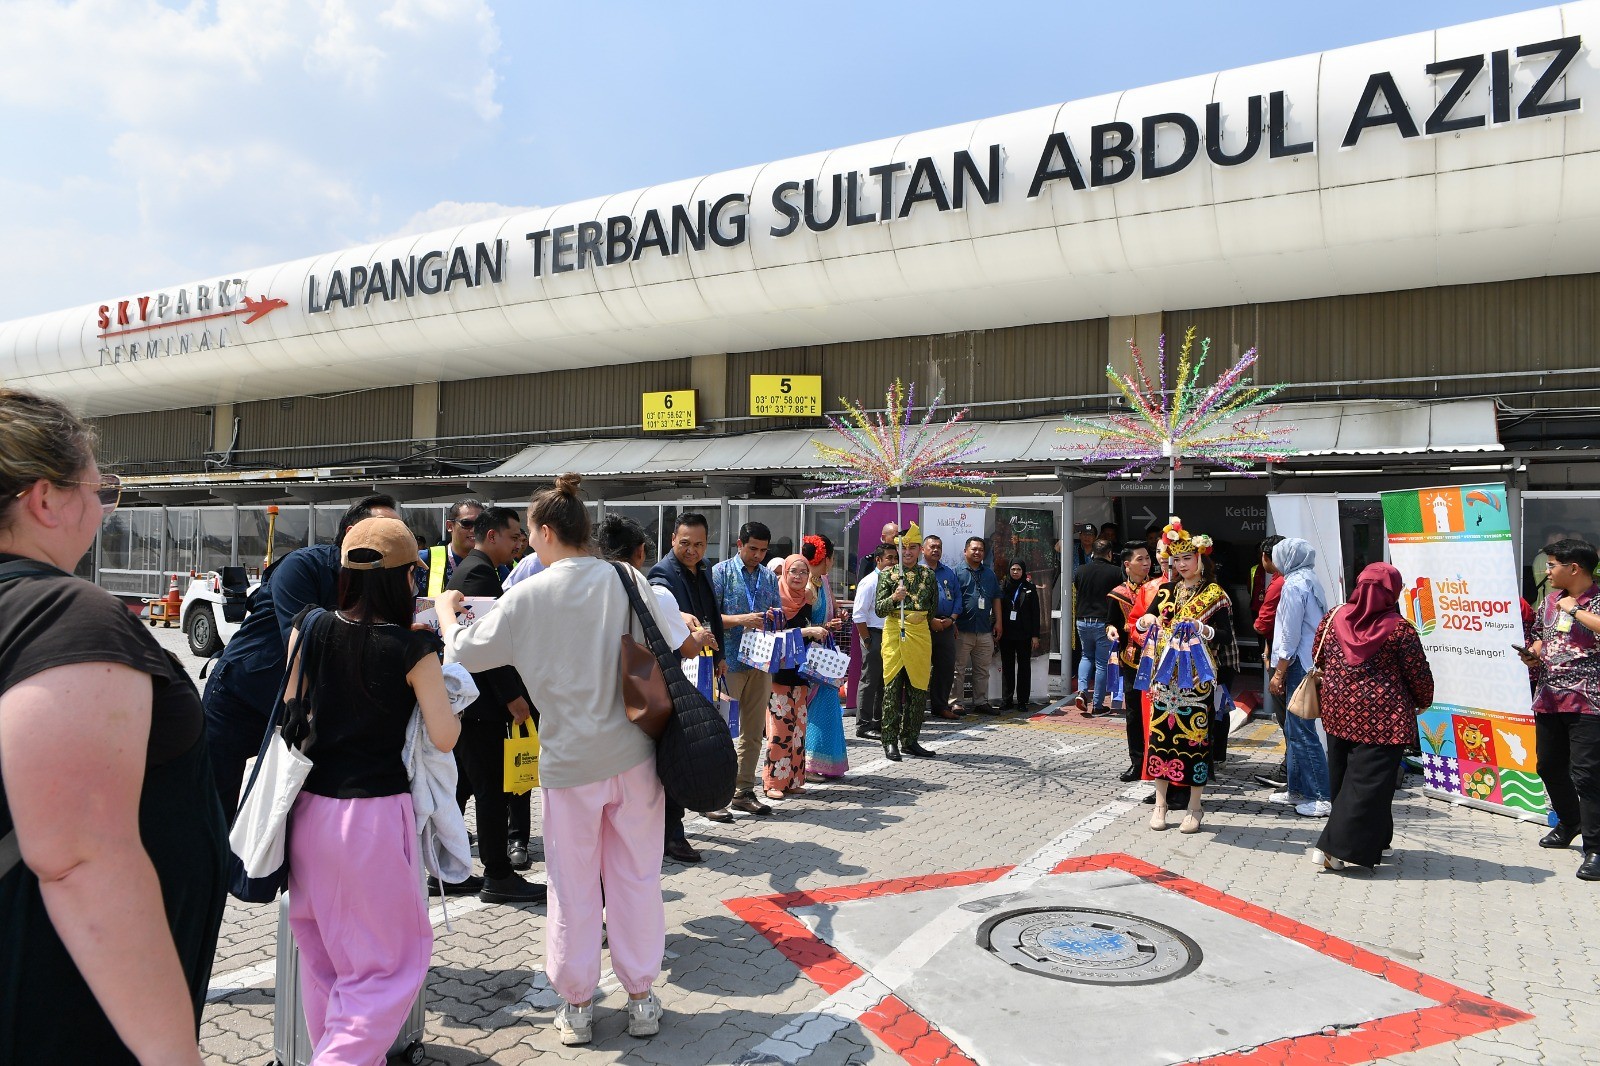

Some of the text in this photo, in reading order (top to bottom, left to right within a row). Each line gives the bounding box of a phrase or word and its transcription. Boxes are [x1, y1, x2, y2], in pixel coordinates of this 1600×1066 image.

[308, 34, 1582, 314] LAPANGAN TERBANG SULTAN ABDUL AZIZ
[97, 279, 231, 330] SKYPARK
[98, 328, 227, 367] TERMINAL
[780, 378, 792, 394] 5
[664, 394, 673, 409] 6
[810, 396, 816, 404] N
[686, 410, 692, 418] N
[810, 405, 816, 413] E
[686, 418, 692, 427] E
[1225, 506, 1267, 517] Ketiba
[1241, 520, 1266, 531] Arri
[1435, 577, 1469, 595] visit
[1439, 595, 1511, 618] Selangor
[1441, 613, 1514, 631] 2025 Malaysia
[1422, 644, 1505, 659] urprising Selangor!
